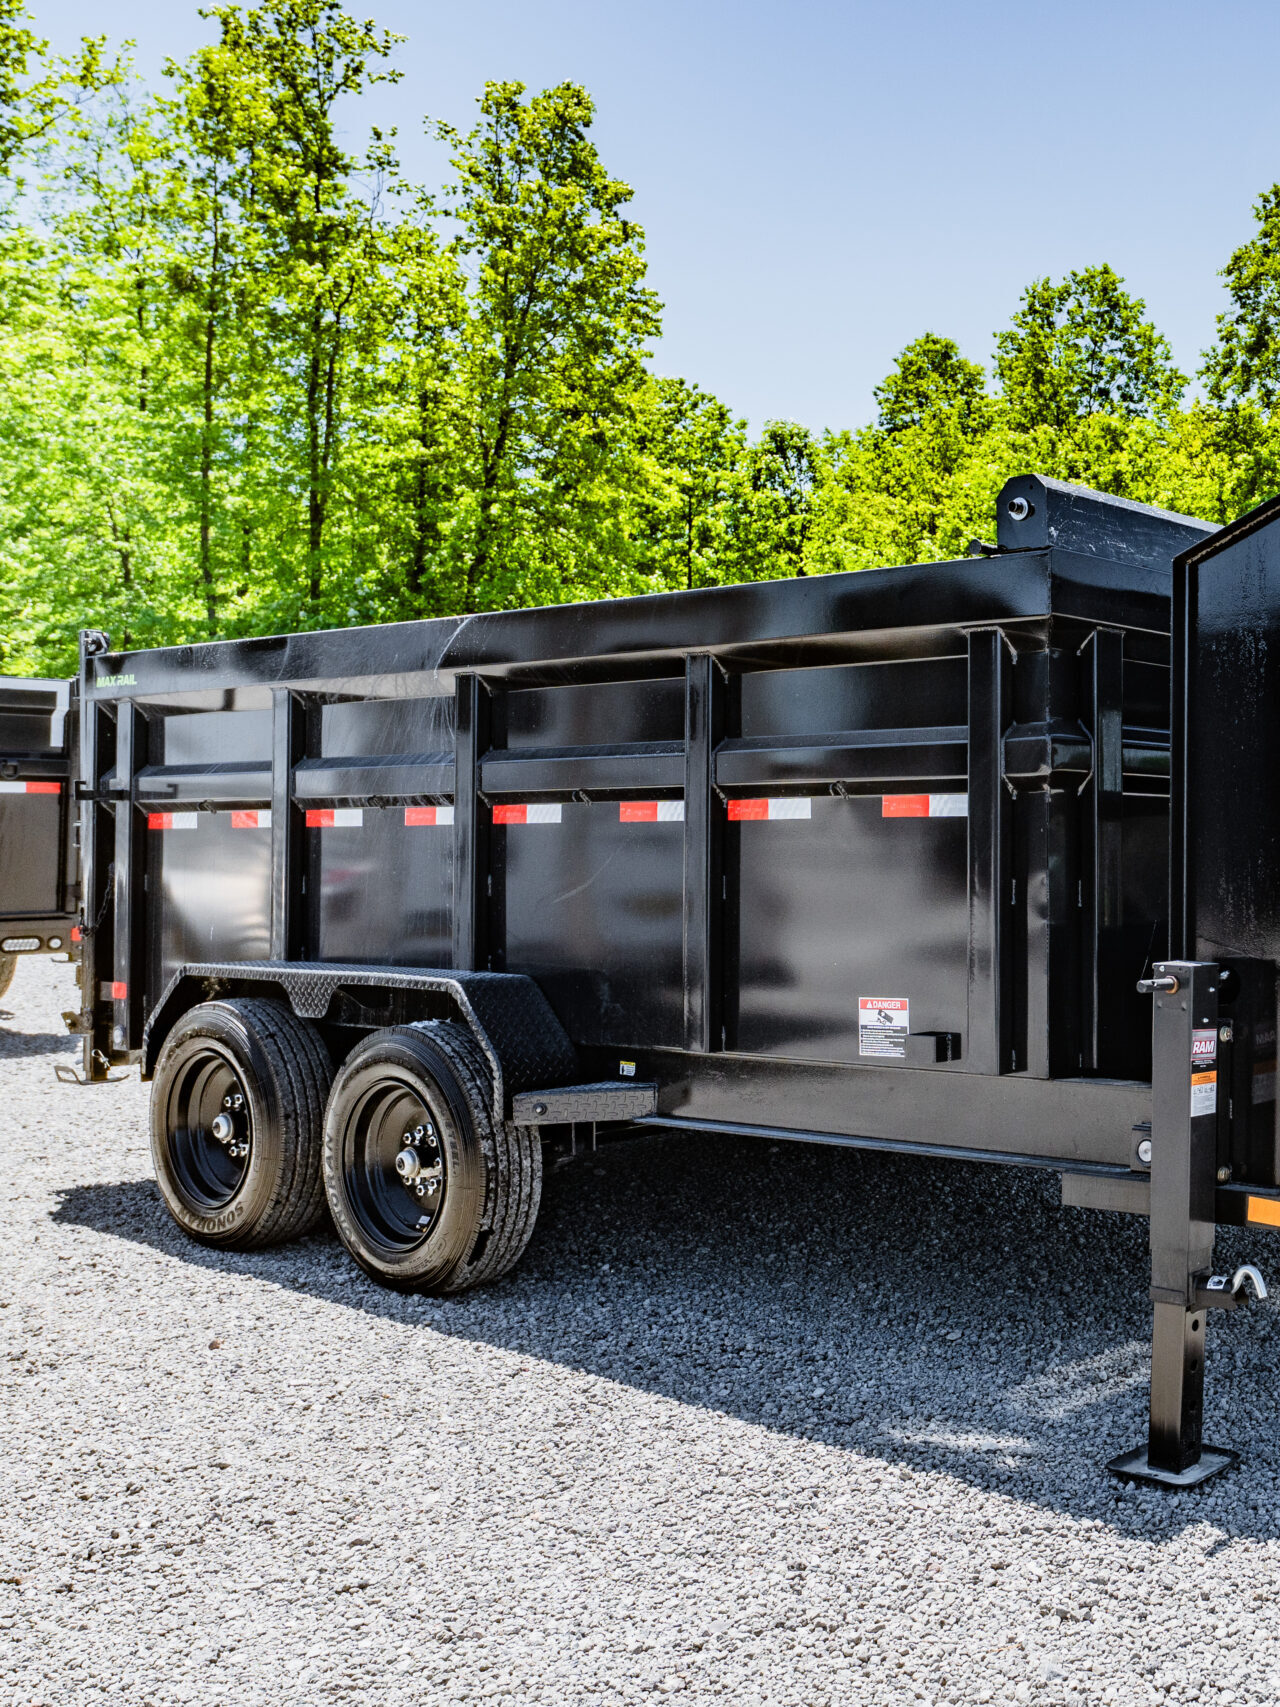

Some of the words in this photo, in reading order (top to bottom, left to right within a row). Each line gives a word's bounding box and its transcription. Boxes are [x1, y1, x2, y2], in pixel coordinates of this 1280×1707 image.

[96, 675, 117, 688] MAX
[117, 674, 137, 686] RAIL
[872, 1000, 901, 1009] DANGER
[1193, 1040, 1215, 1054] RAM
[178, 1201, 244, 1232] SONORAN
